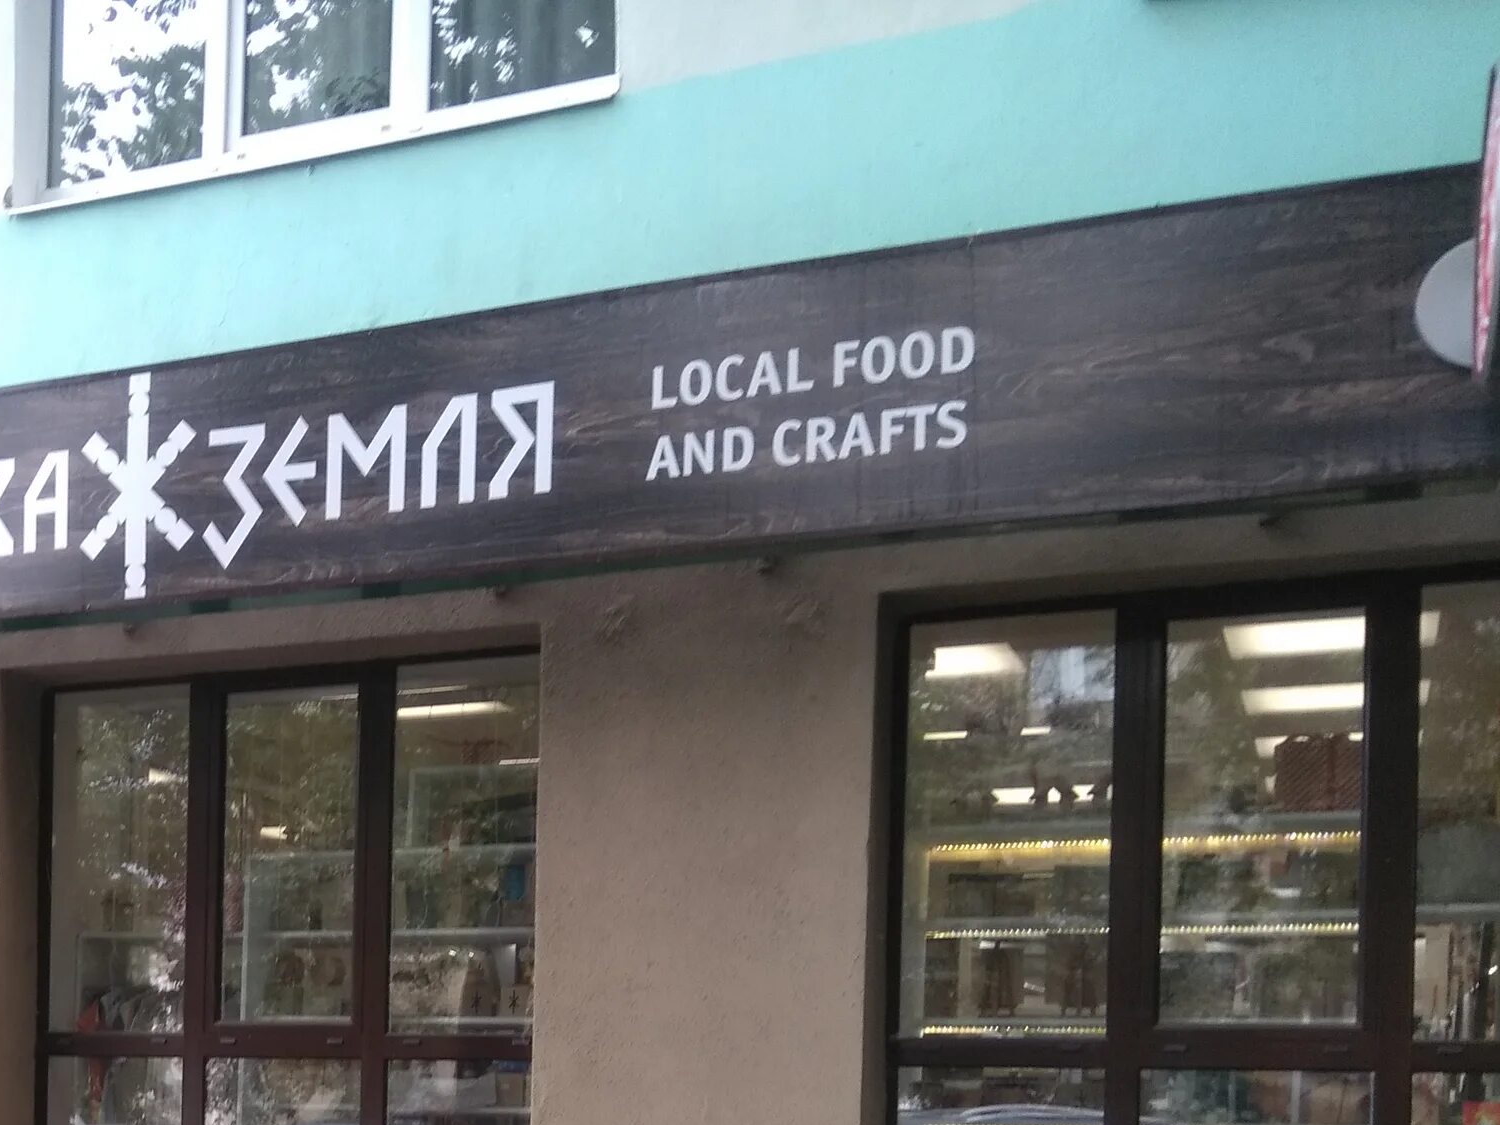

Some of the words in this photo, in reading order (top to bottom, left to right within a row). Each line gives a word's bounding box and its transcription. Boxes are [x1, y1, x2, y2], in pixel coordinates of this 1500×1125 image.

[651, 346, 814, 411] LOCAL
[832, 325, 976, 388] FOOD
[202, 380, 556, 569] ЗЕМЛЯ
[644, 425, 755, 482] AND
[771, 399, 968, 467] CRAFTS
